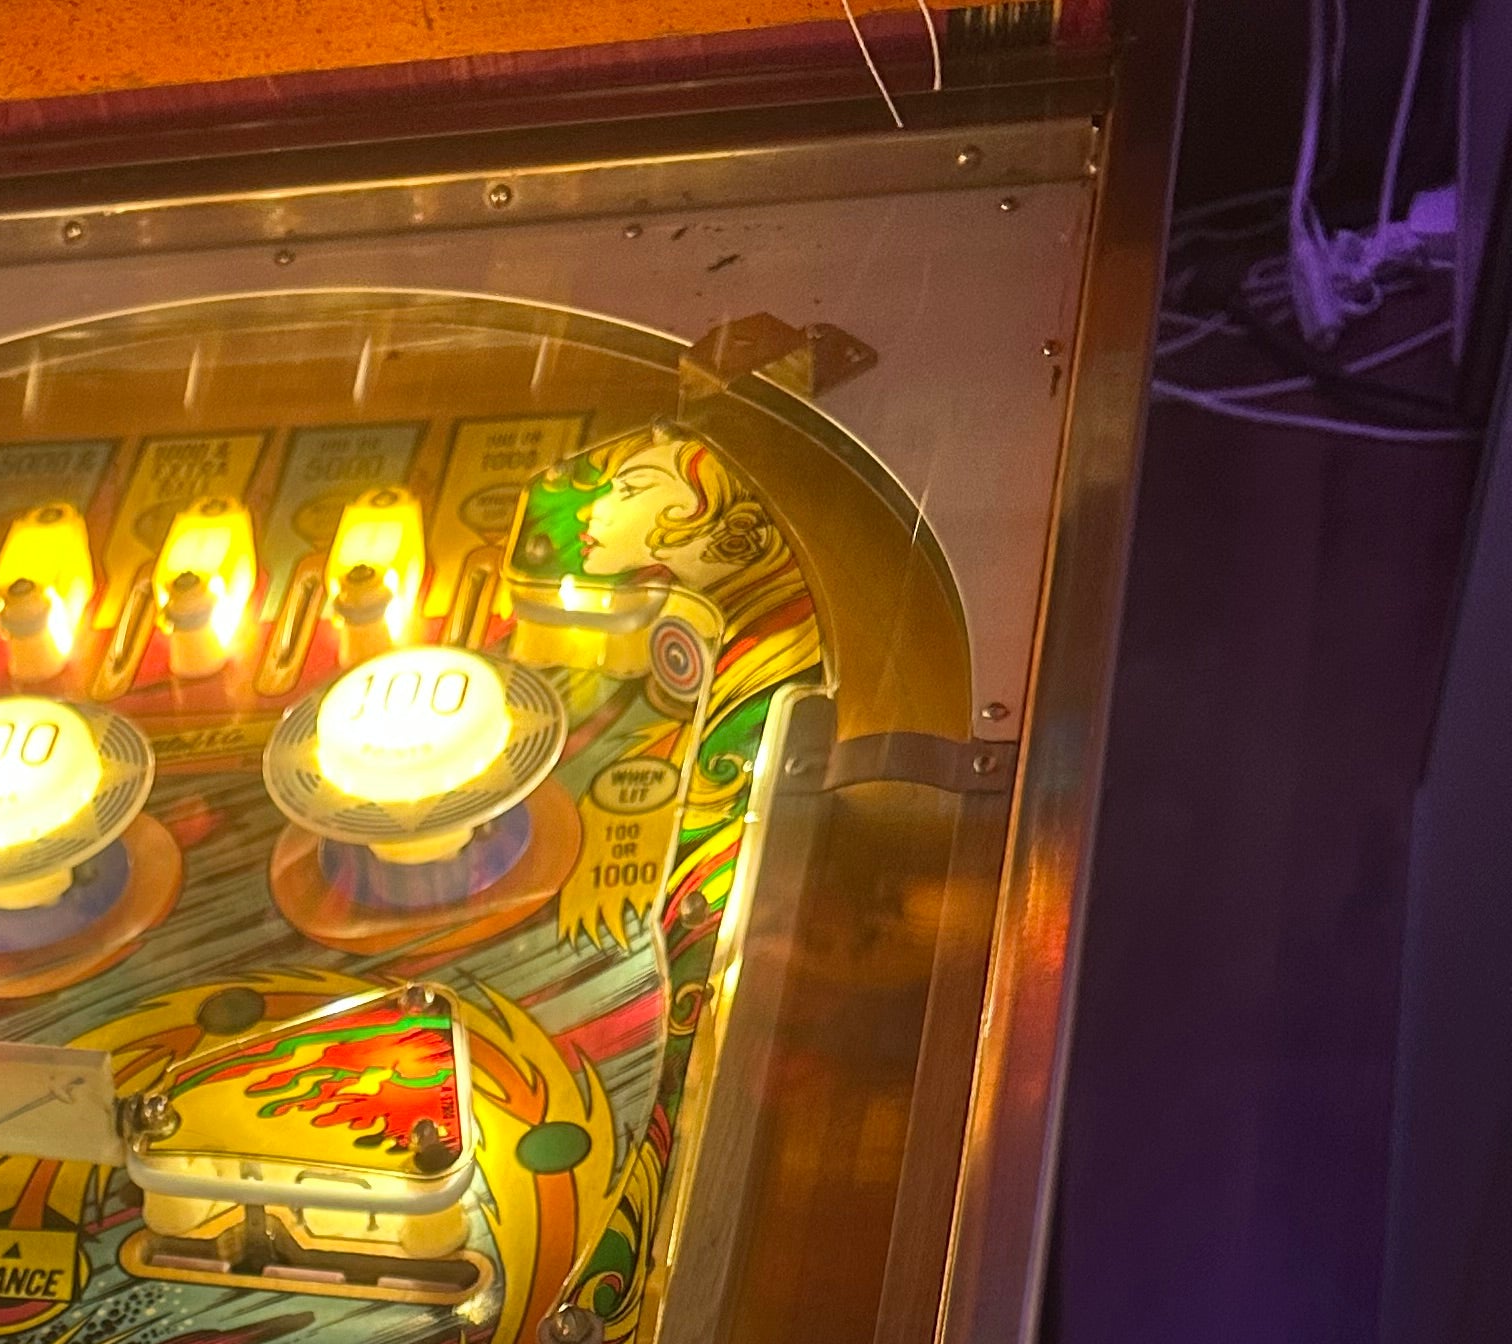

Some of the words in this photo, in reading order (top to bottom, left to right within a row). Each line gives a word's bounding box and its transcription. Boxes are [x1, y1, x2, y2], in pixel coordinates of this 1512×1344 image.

[349, 670, 470, 721] 100
[611, 769, 666, 786] WHEN
[605, 822, 640, 843] 100
[611, 842, 638, 860] OR
[591, 861, 657, 889] 1000
